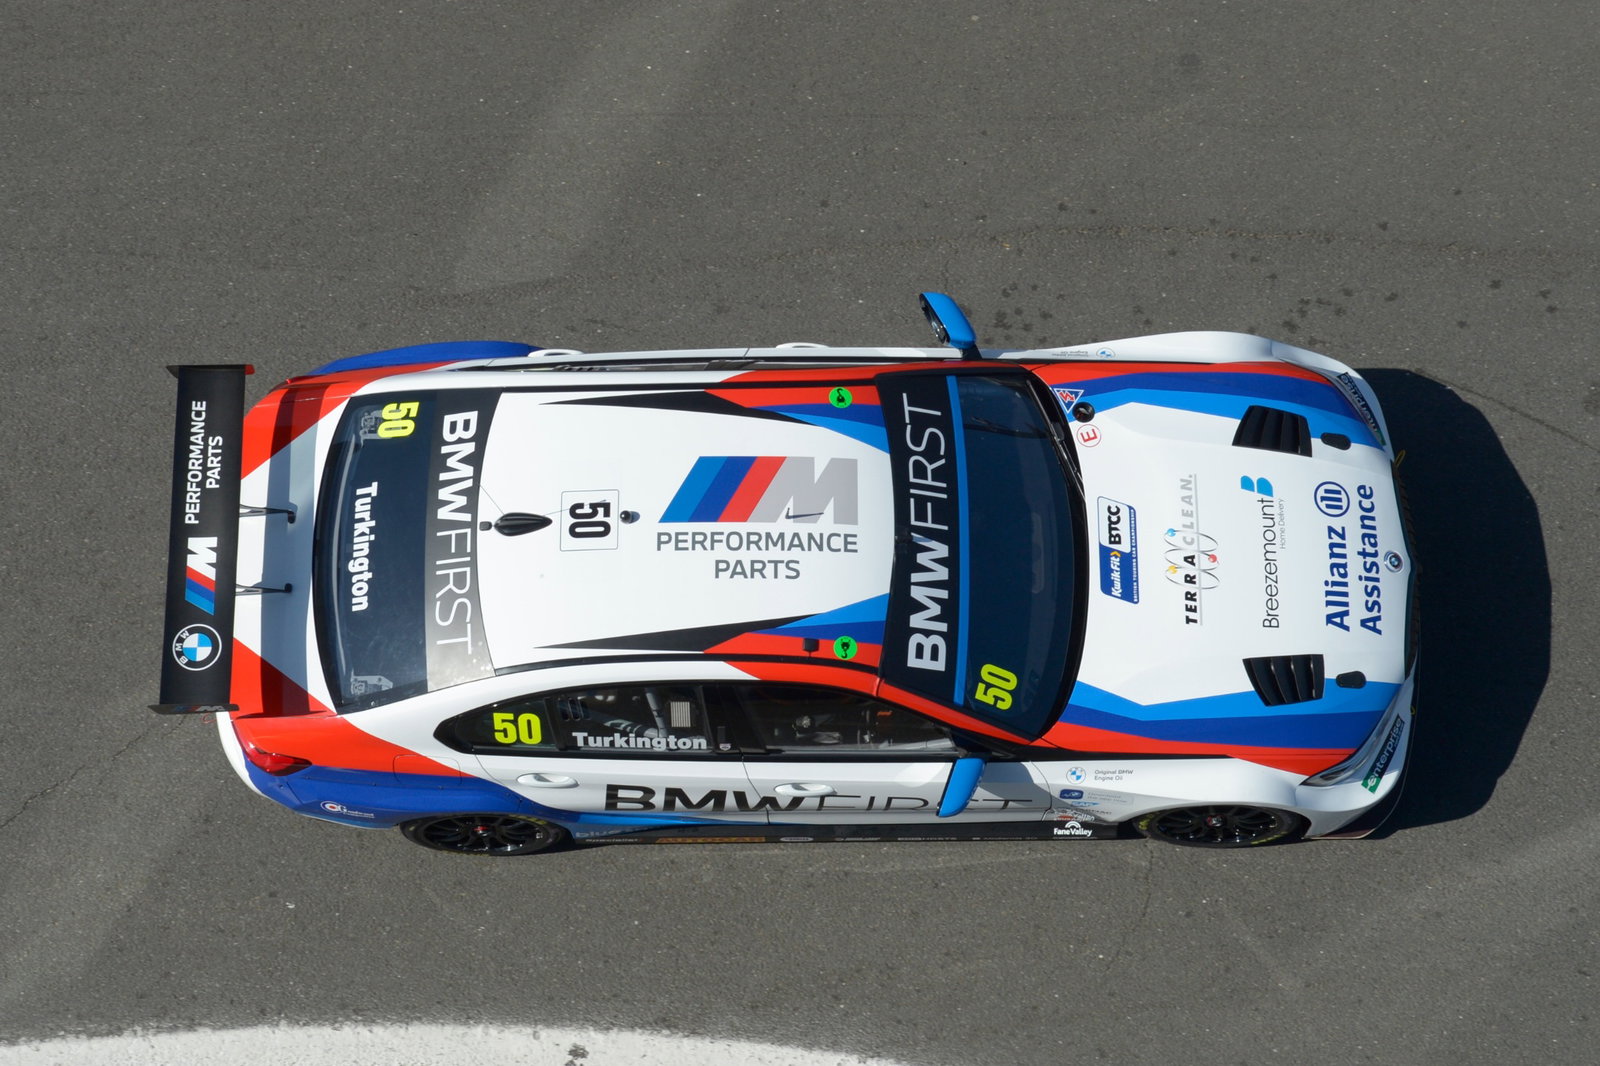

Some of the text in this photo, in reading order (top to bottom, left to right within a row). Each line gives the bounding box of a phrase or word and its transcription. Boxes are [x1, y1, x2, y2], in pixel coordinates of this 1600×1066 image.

[377, 402, 420, 438] 50
[185, 400, 206, 524] PERFORMANCE
[205, 435, 223, 488] PARTS
[568, 501, 612, 539] 50
[1107, 505, 1122, 545] BTCC
[1278, 499, 1287, 526] Delivery
[348, 481, 378, 612] Turkington
[656, 531, 859, 553] PERFORMANCE
[1357, 484, 1383, 636] Assistance
[714, 559, 801, 580] PARTS
[1257, 498, 1280, 629] Breezemount
[1324, 525, 1350, 632] Allianz
[974, 663, 1018, 711] 50
[492, 712, 542, 746] 50
[572, 732, 707, 751] Turkington
